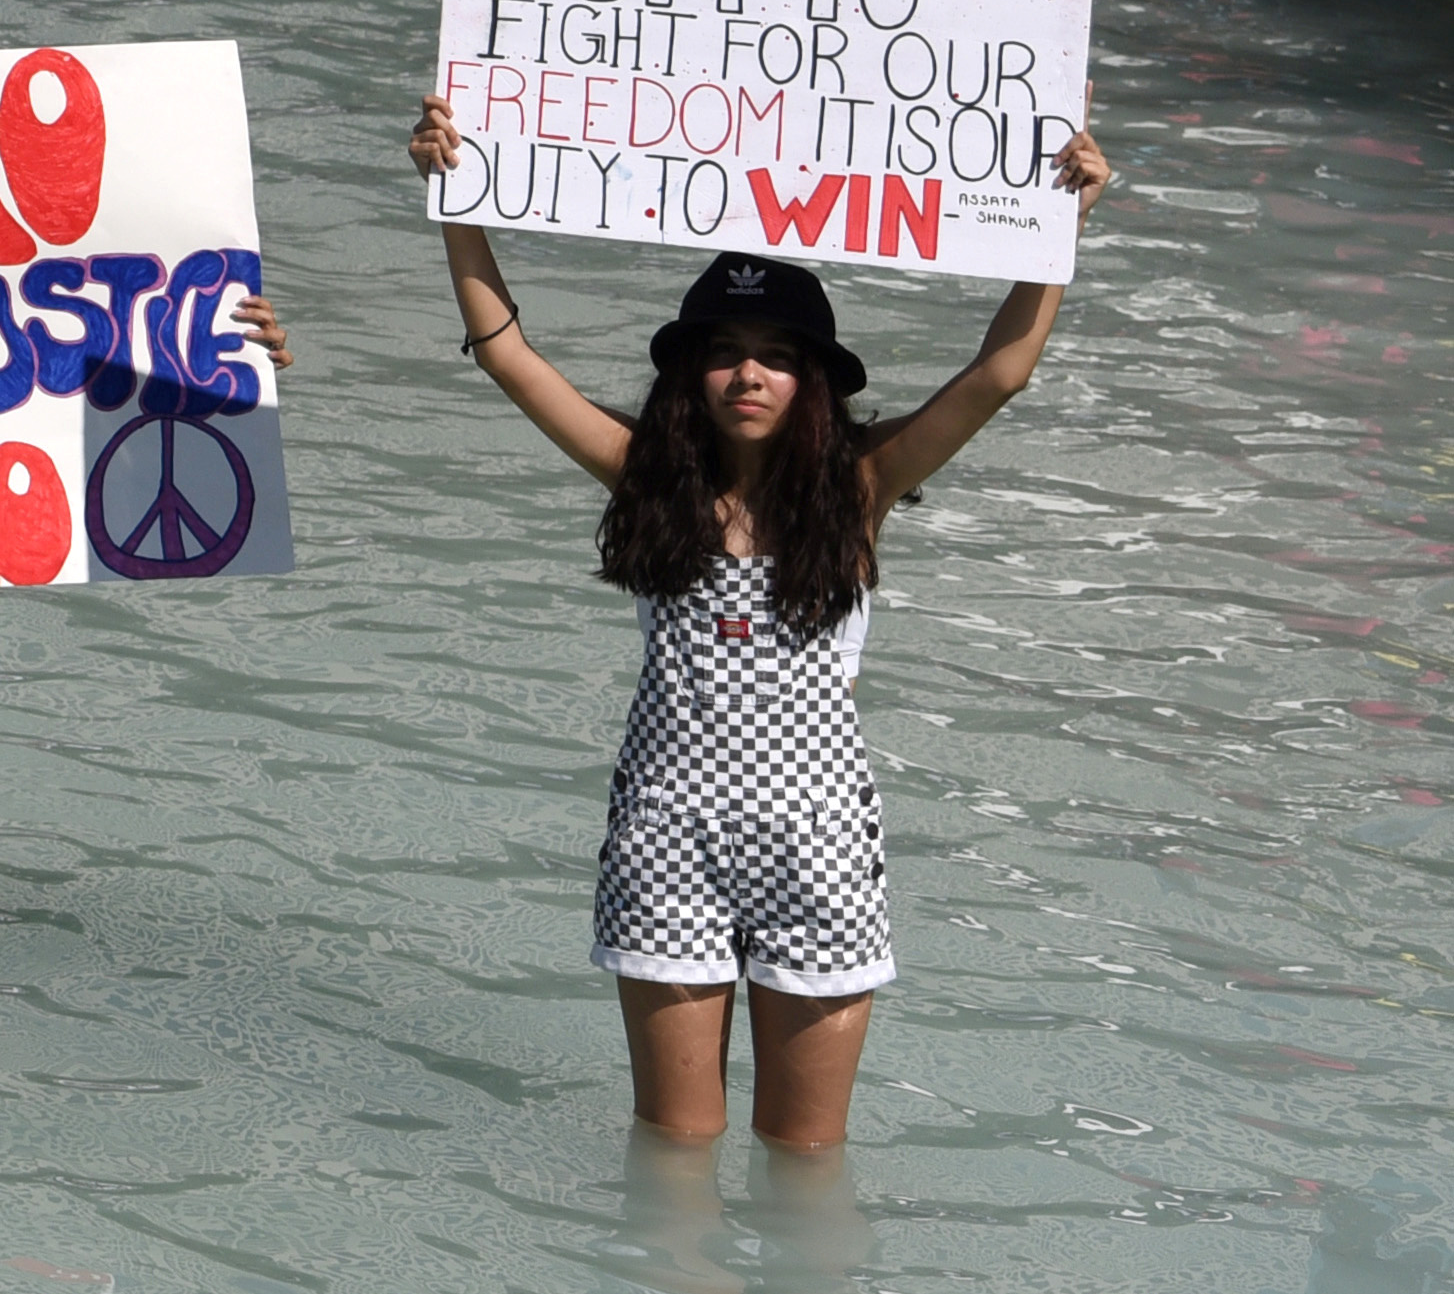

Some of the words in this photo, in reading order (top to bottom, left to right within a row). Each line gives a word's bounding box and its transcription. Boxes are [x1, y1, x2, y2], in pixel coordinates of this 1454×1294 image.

[721, 19, 850, 95] FOR
[883, 31, 1037, 112] OUR
[445, 61, 785, 162] FREEDOM
[438, 135, 621, 231] DUTY
[644, 154, 728, 244] TO
[745, 166, 943, 261] WIN
[957, 192, 1021, 209] ASSATA
[976, 213, 1042, 233] SHAKUR
[726, 284, 766, 295] adidas
